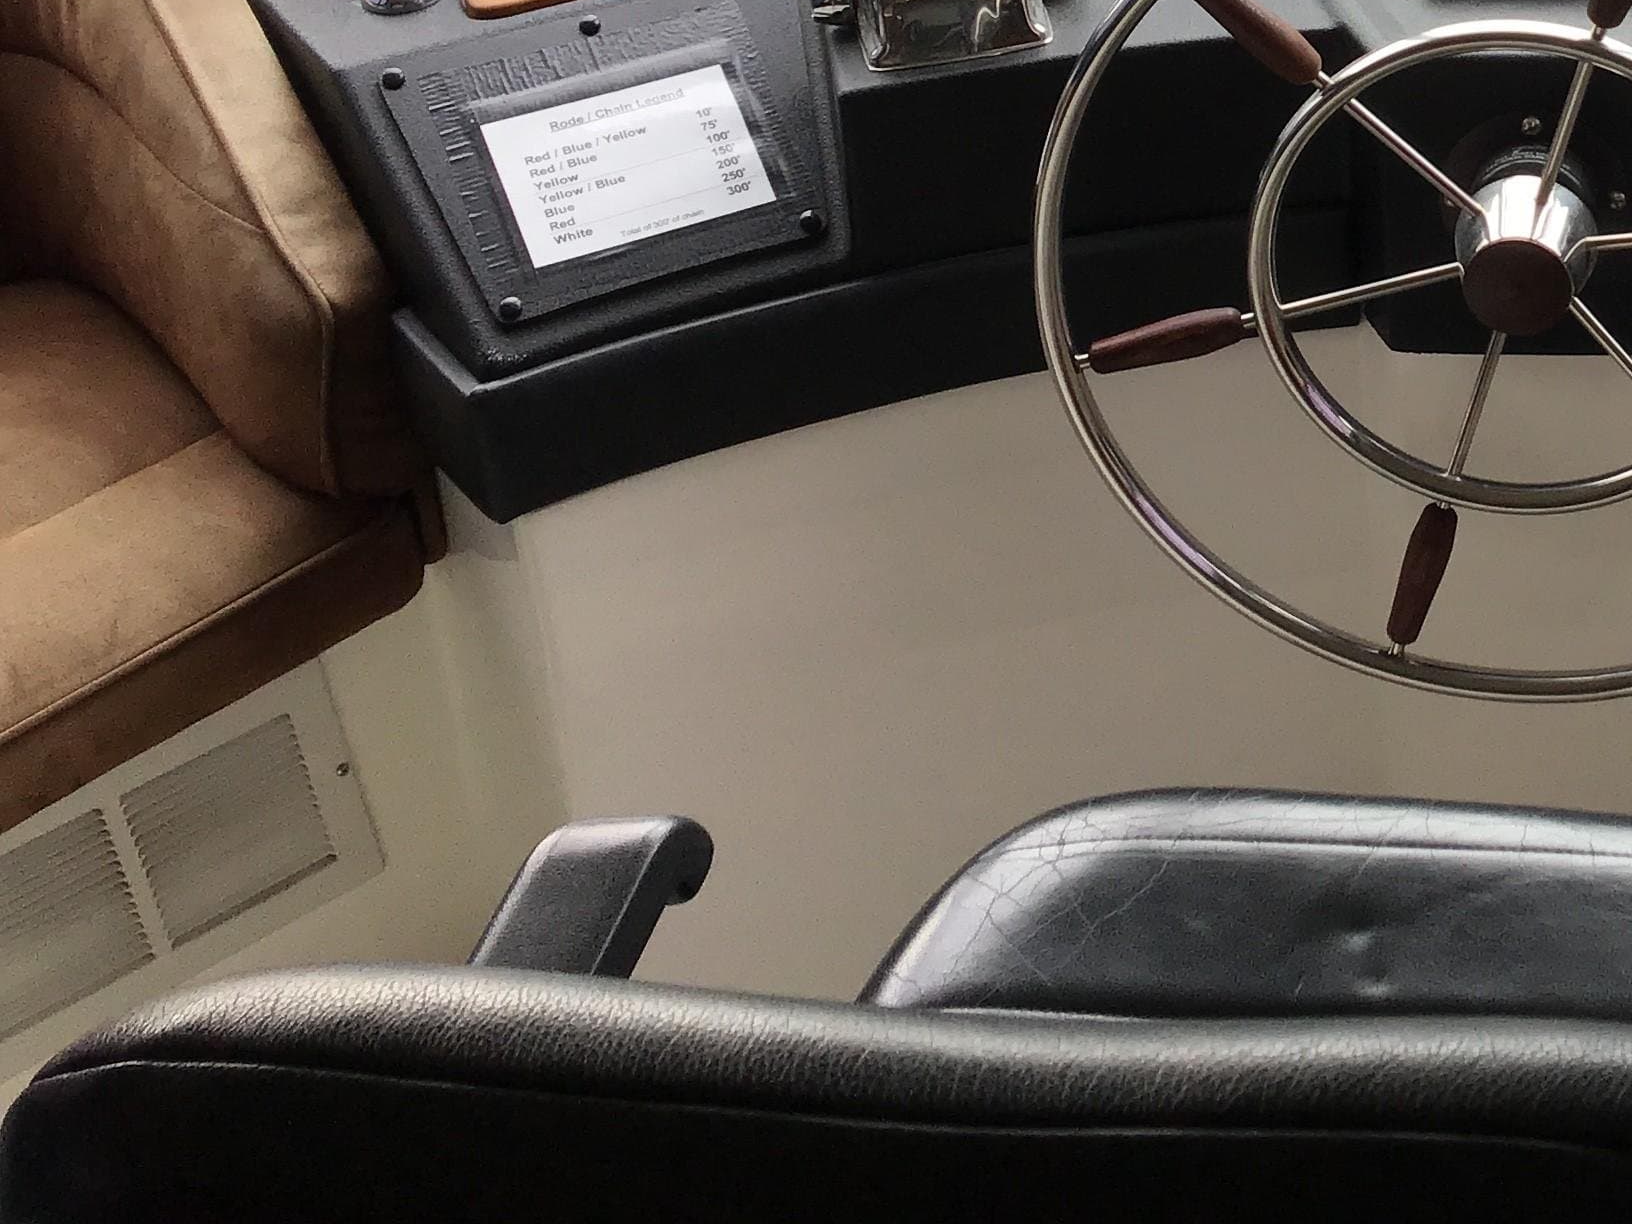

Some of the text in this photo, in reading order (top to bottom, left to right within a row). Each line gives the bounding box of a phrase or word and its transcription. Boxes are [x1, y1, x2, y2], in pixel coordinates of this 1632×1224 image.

[549, 115, 584, 131] Rode
[595, 102, 633, 120] Chain
[635, 88, 685, 109] Legend
[524, 151, 551, 166] Red
[562, 140, 593, 156] Blue
[602, 126, 647, 144] Yellow
[529, 165, 556, 179] Red
[567, 154, 598, 169] Blue
[534, 173, 579, 191] Yellow
[538, 187, 584, 205] Yellow
[595, 175, 626, 190] Blue
[544, 203, 576, 219] Blue
[550, 217, 577, 232] Red
[553, 227, 594, 245] White
